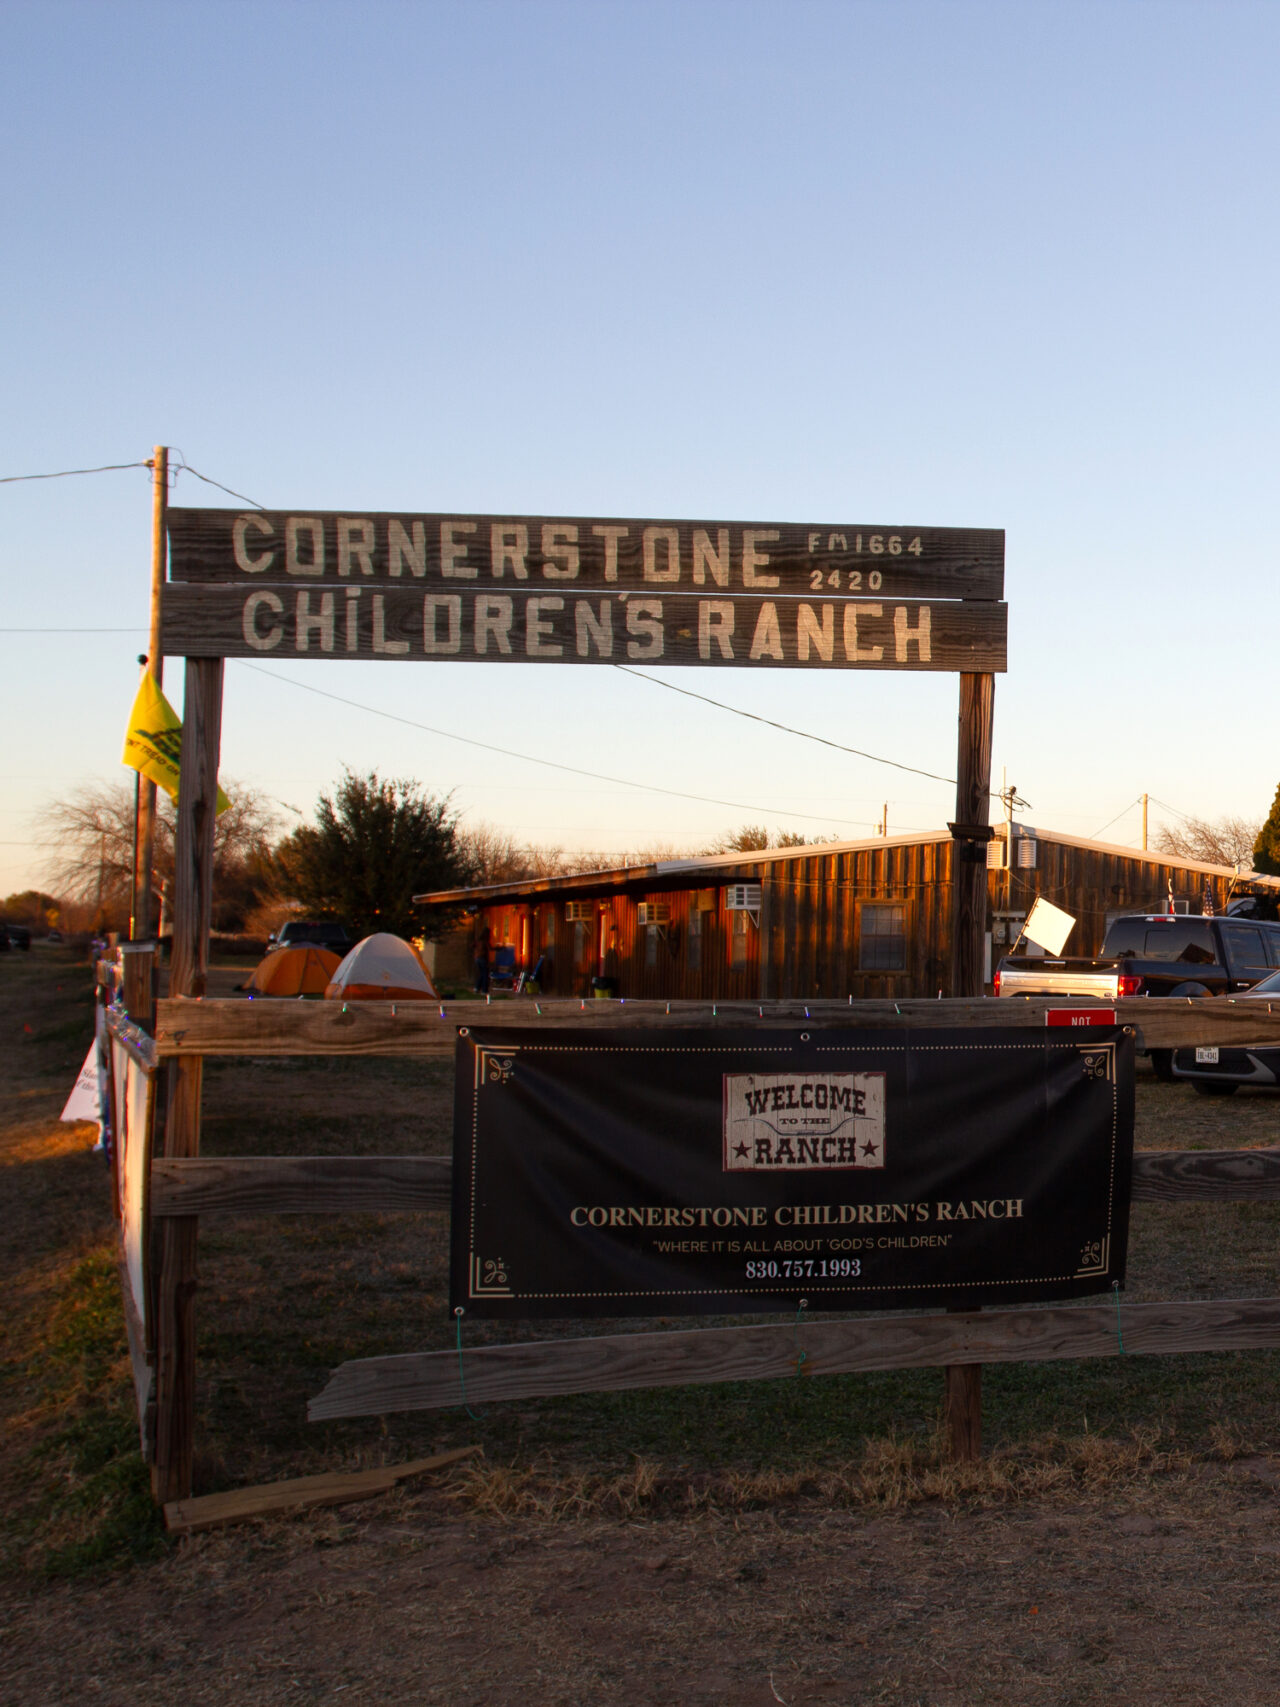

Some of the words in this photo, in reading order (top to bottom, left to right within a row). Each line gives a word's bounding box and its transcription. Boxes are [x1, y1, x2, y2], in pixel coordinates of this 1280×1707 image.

[233, 513, 780, 588] CORNERSTONE
[810, 570, 882, 590] 2420
[699, 600, 932, 662] RANCH
[1071, 1016, 1091, 1026] NOT
[745, 1084, 866, 1116] WELCOME
[755, 1137, 856, 1164] RANCH
[570, 1206, 767, 1227] CORNERSTONE
[774, 1202, 929, 1225] CHILDREN'S
[936, 1199, 1024, 1221] RANCH
[653, 1240, 708, 1252] "WHERE
[712, 1240, 725, 1252] IT
[728, 1240, 740, 1252] IS
[744, 1240, 770, 1252] ALL
[773, 1239, 823, 1252] ABOUT
[826, 1237, 874, 1250] 'GOD'S
[877, 1234, 952, 1249] CHILDREN"
[745, 1258, 861, 1279] 830.757.1993
